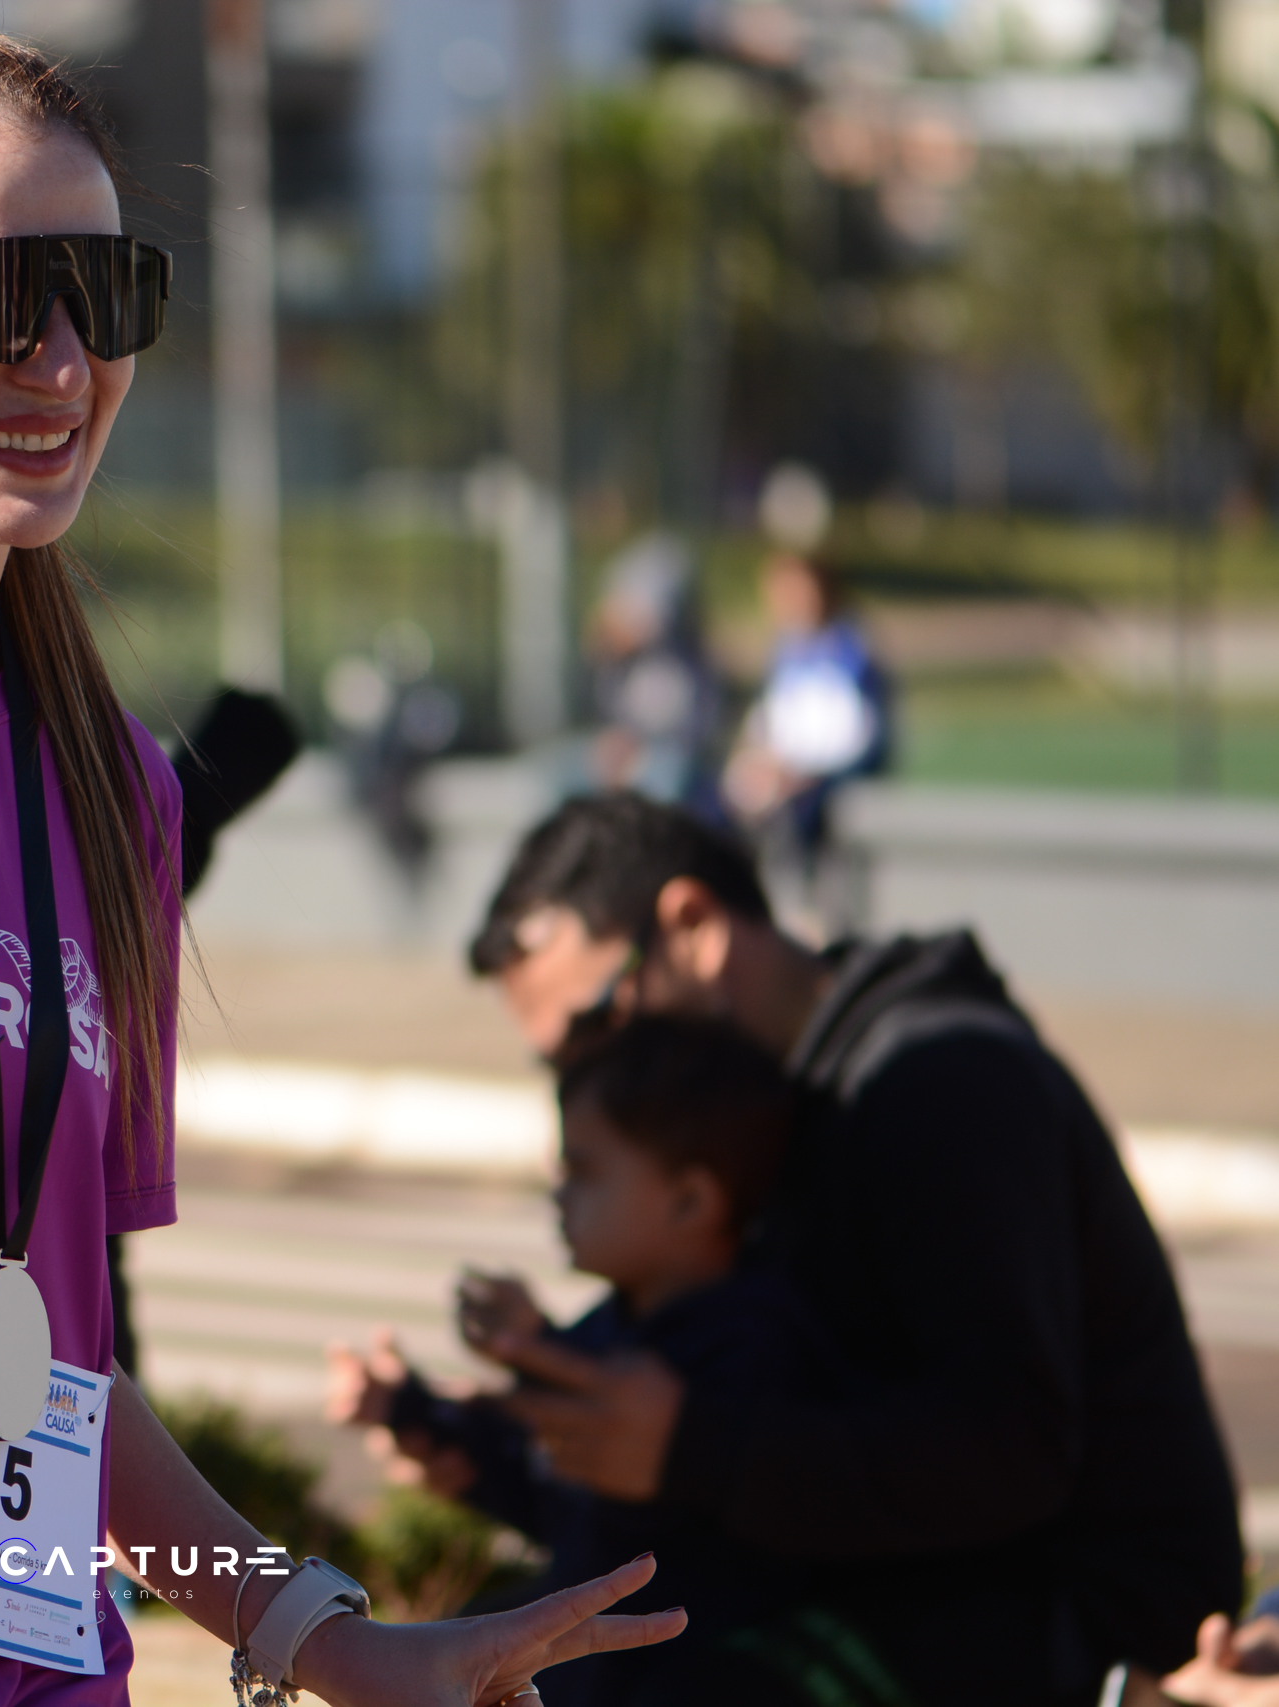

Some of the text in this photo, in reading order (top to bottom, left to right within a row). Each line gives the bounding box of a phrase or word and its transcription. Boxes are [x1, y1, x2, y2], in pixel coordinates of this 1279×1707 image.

[45, 1412, 76, 1436] CAUSA
[12, 1552, 34, 1568] Corrida
[34, 1558, 40, 1569] 5
